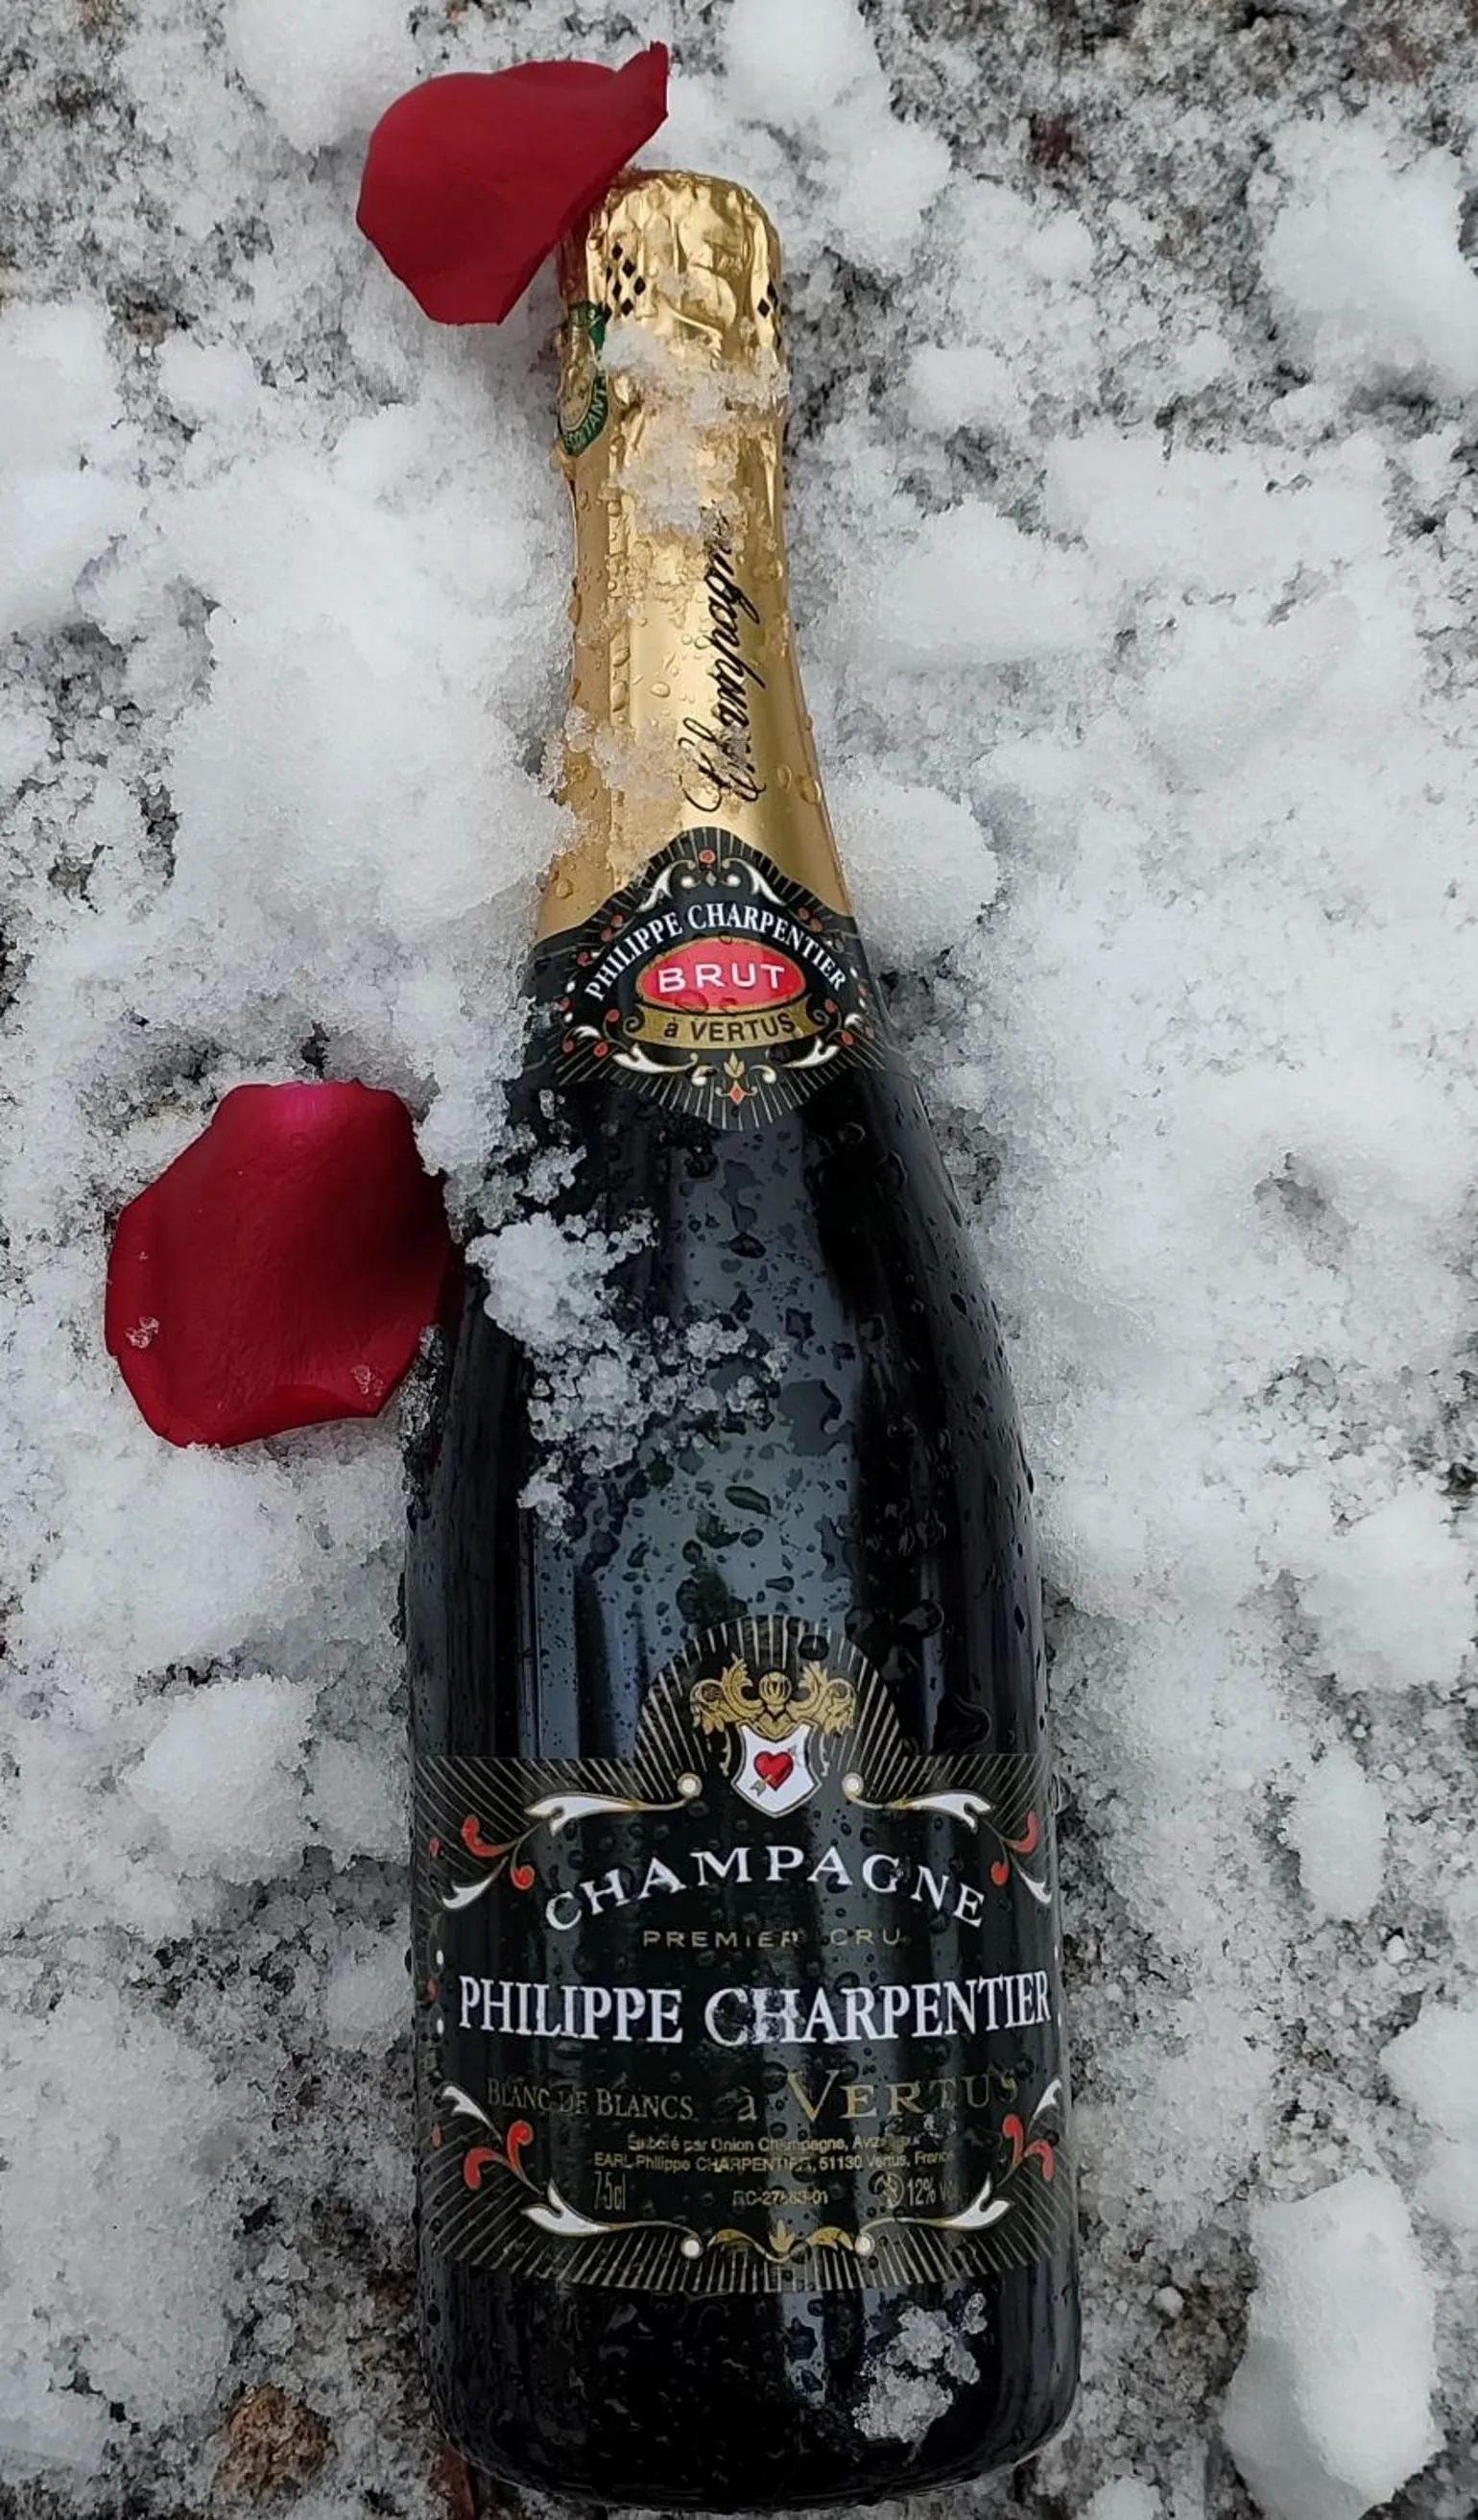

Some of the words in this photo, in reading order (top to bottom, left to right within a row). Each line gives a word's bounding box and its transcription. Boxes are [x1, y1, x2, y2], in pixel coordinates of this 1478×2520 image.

[584, 912, 683, 1001] PHILIPPE
[687, 902, 846, 992] CHARPENTIER
[658, 963, 785, 993] BRUT
[663, 1016, 678, 1038] à
[691, 1013, 796, 1042] VERTUS
[545, 1846, 985, 1931] CHAMPAGNE
[643, 1930, 799, 1949] PREMIER
[830, 1927, 900, 1947] CRU
[459, 1975, 683, 2043] PHILIPPE
[704, 1970, 1051, 2047] CHARPENTIER
[487, 2077, 553, 2111] BLANC
[596, 2088, 694, 2120] BLANCS
[787, 2069, 1018, 2122] VERTUS
[682, 2138, 708, 2154] par
[819, 2153, 863, 2172] 51130
[906, 2176, 937, 2207] 12%
